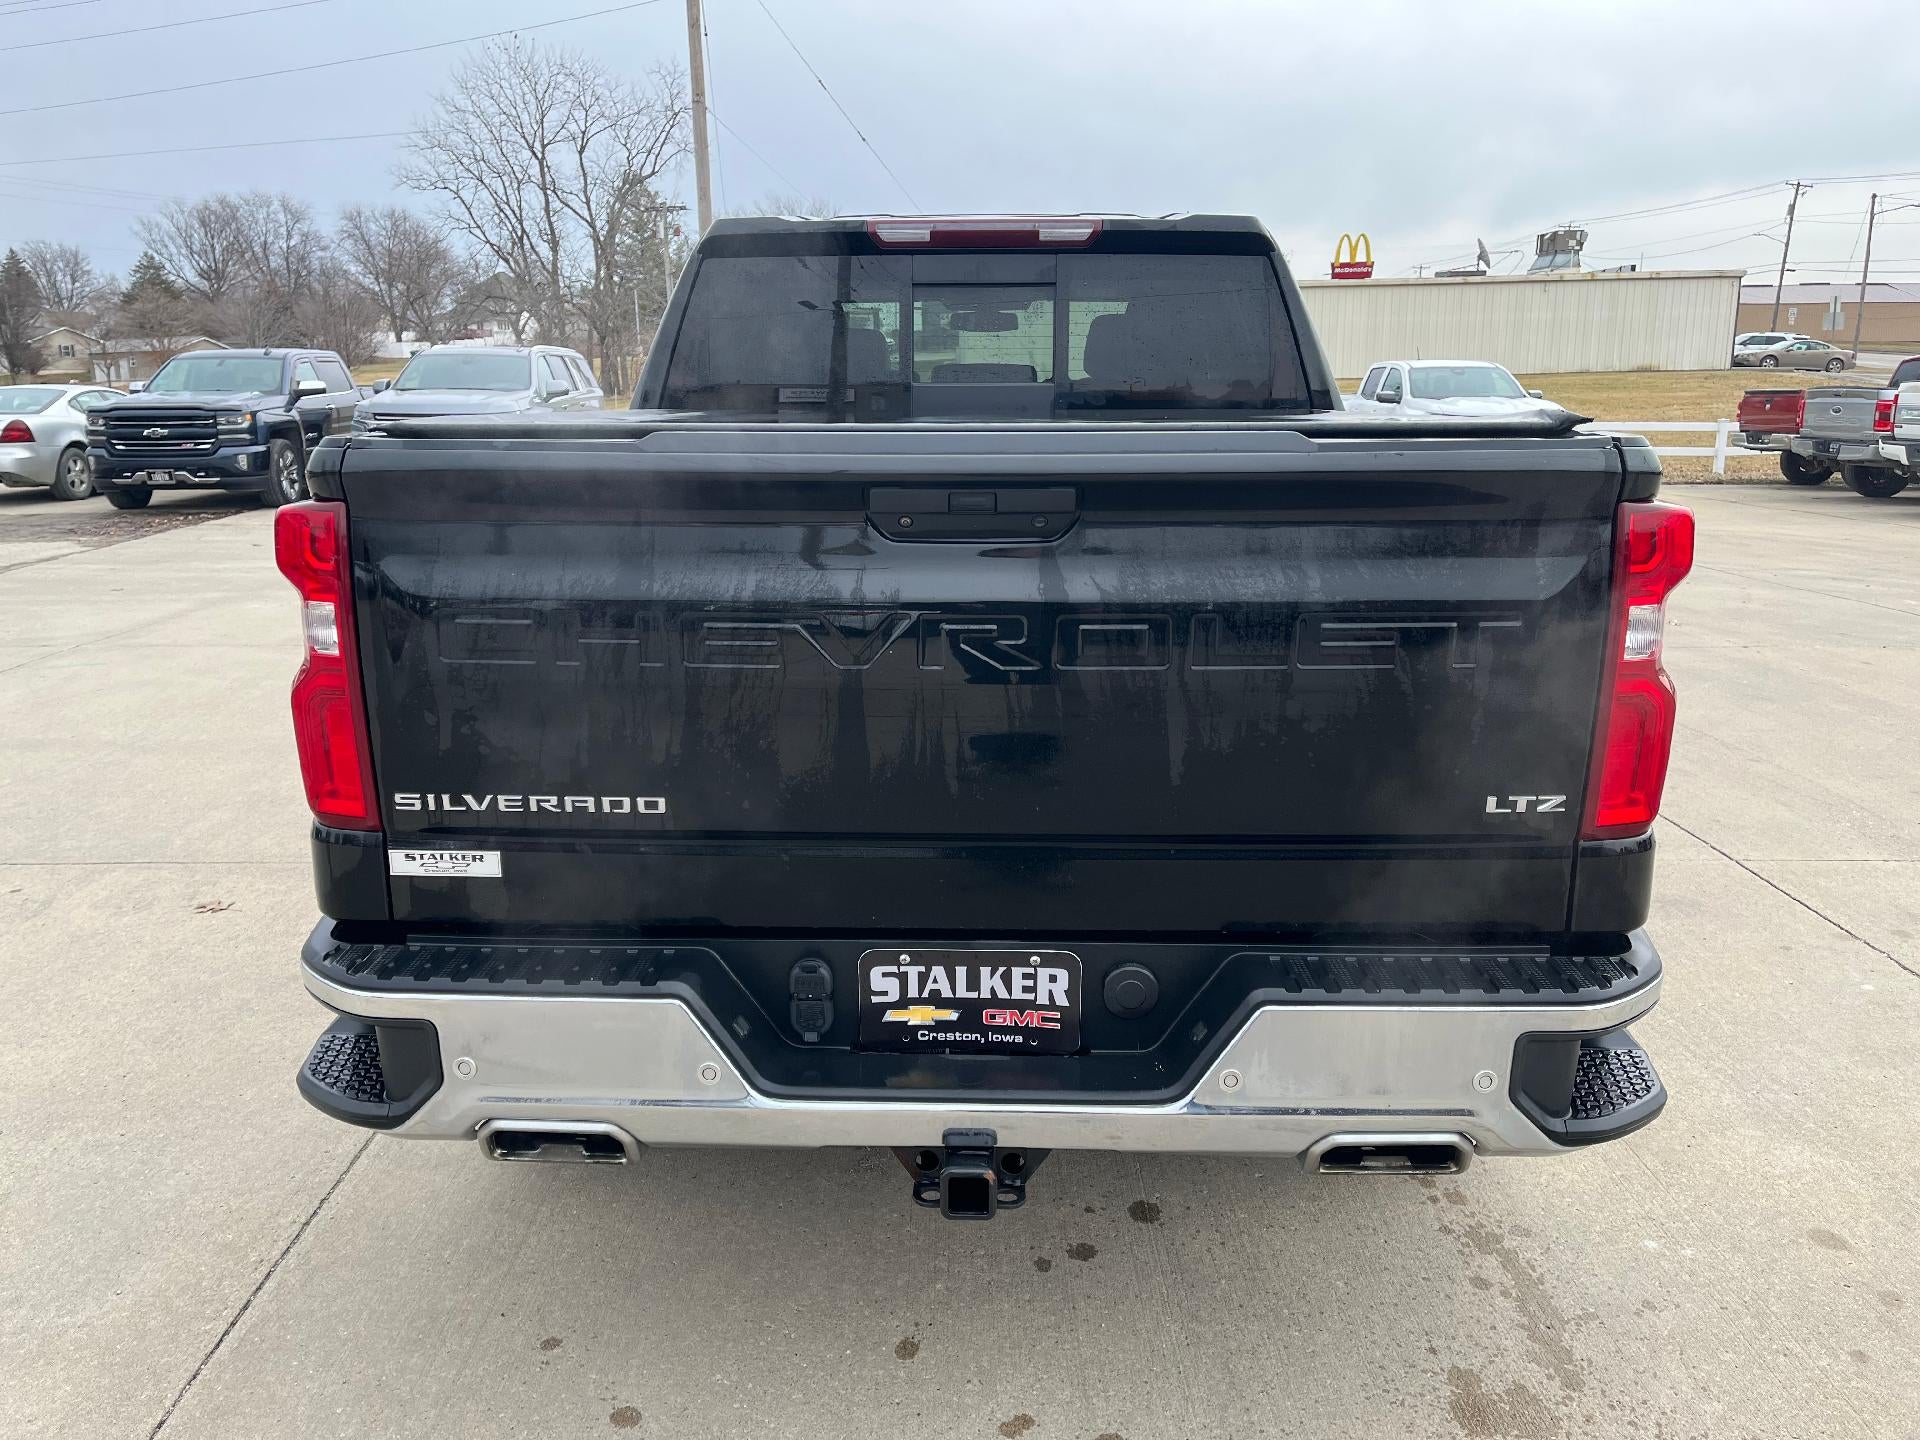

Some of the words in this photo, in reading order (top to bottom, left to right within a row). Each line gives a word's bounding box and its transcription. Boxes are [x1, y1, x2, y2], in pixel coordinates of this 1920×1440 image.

[437, 609, 1524, 671] CHEVROLET
[394, 793, 667, 814] SILVERADO
[1485, 795, 1567, 813] LTZ
[403, 853, 485, 863] STALKER
[869, 965, 1070, 1007] STALKER
[982, 1008, 1061, 1029] GMC
[917, 1030, 985, 1044] Creston,
[988, 1031, 1024, 1043] Iowa
